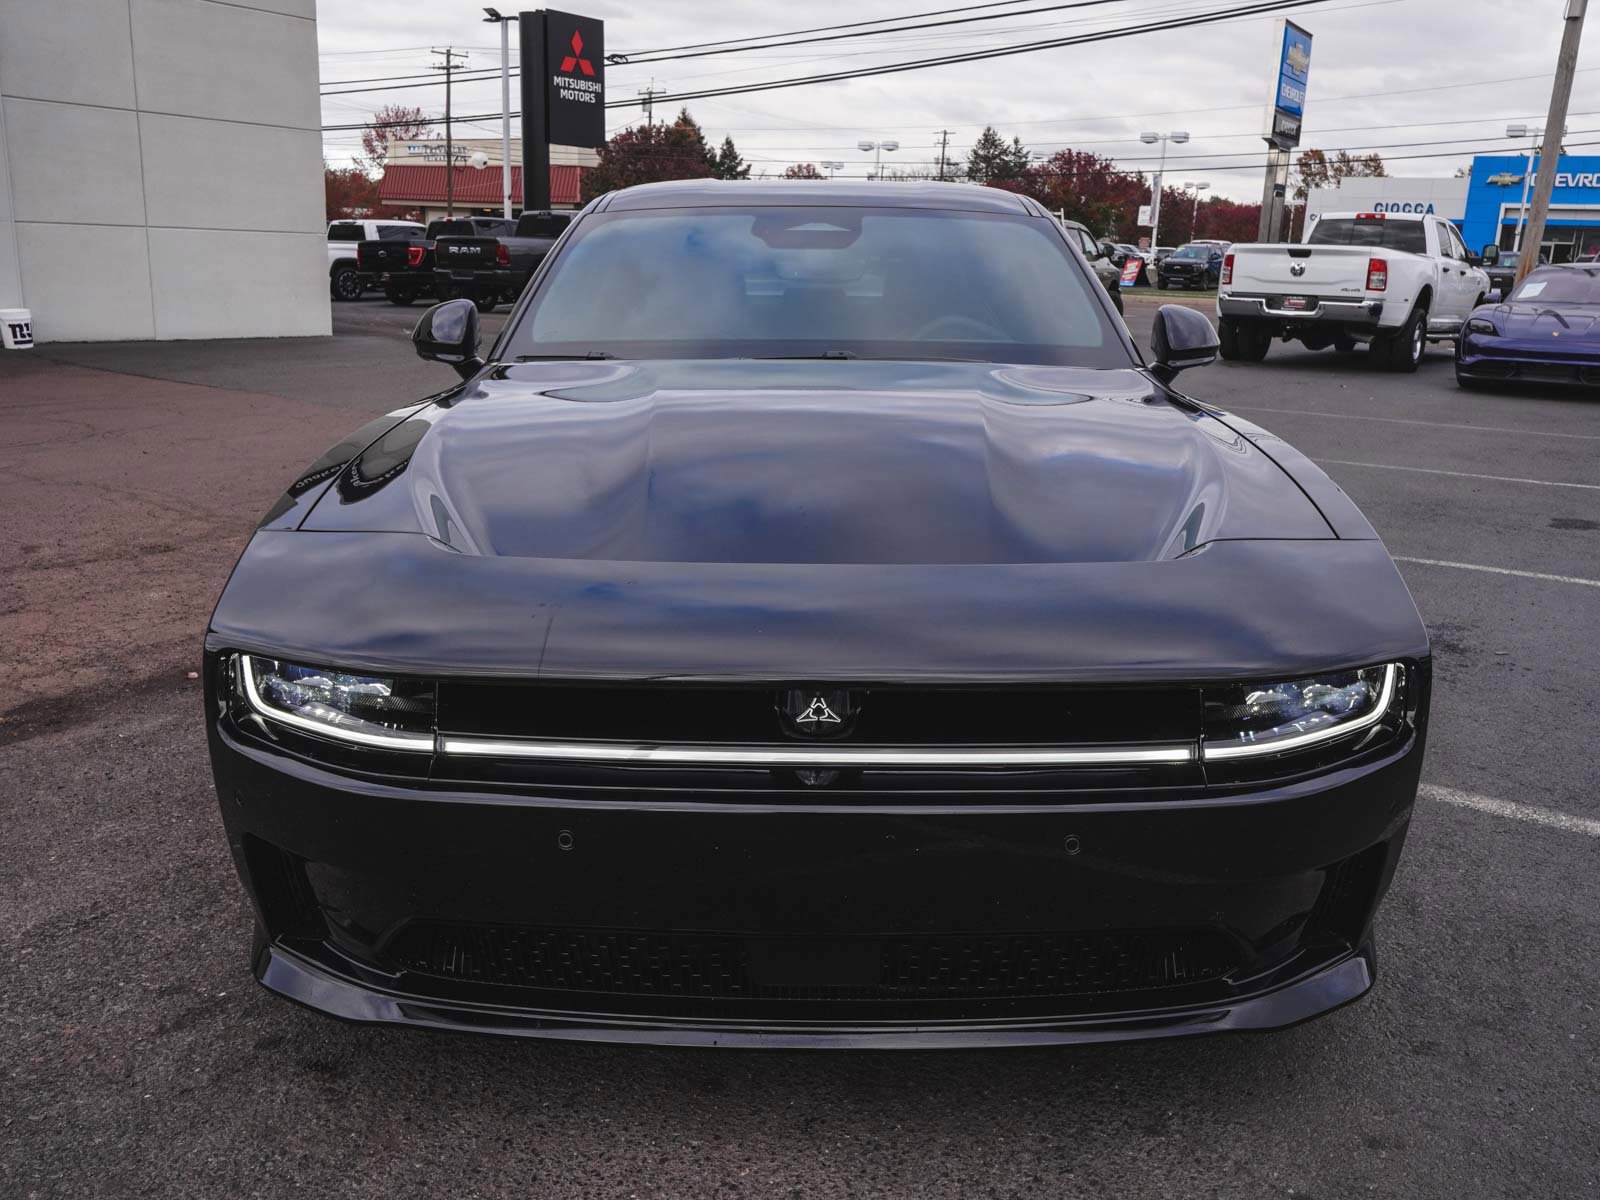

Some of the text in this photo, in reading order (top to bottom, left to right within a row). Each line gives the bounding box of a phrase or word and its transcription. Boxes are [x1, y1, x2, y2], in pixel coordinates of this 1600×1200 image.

[553, 76, 602, 93] MITSUBISHI
[560, 89, 596, 103] MOTORS
[448, 246, 481, 254] RAM
